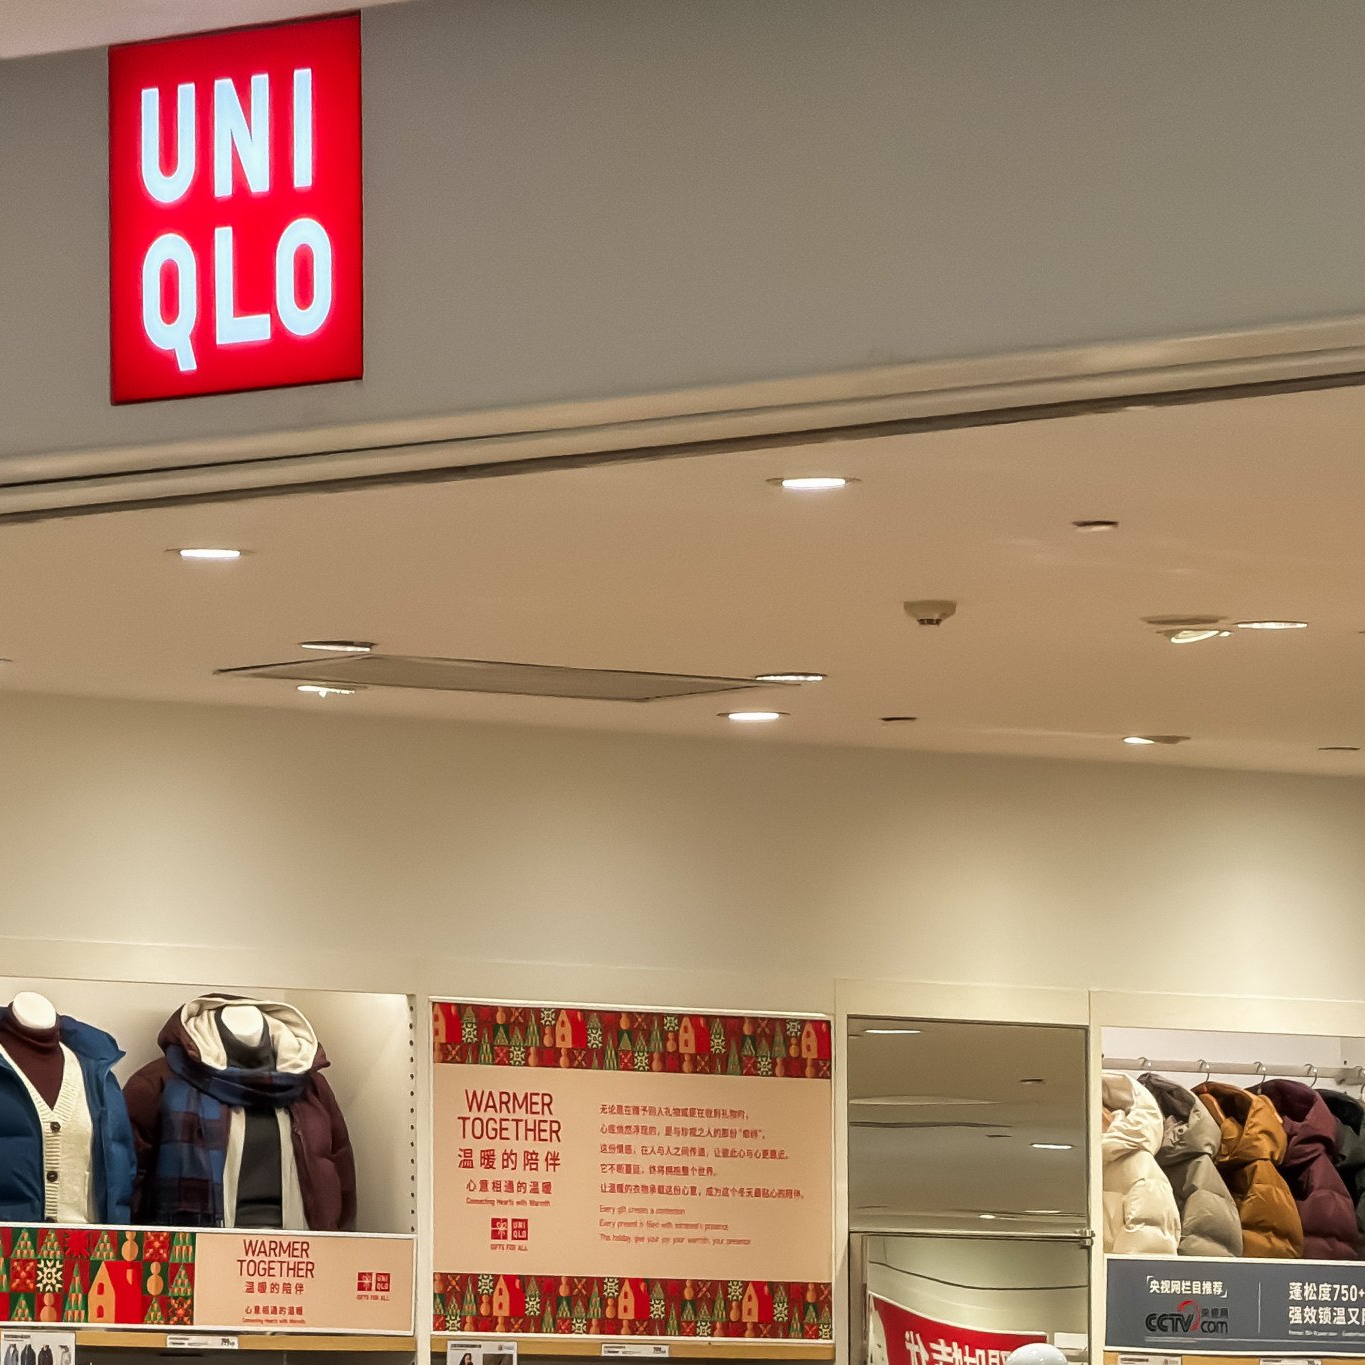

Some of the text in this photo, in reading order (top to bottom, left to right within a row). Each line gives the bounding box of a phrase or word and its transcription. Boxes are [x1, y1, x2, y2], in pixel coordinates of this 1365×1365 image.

[141, 67, 312, 203] UNI
[142, 218, 332, 371] QLO
[465, 1089, 554, 1115] WARMER
[457, 1116, 562, 1143] TOGETHER
[458, 1148, 561, 1173] 温暖的陪伴
[466, 1179, 552, 1195] 心意相通的温暖
[243, 1239, 310, 1258] WARMER
[237, 1259, 315, 1278] TOGETHER
[245, 1281, 304, 1295] 温暖的陪伴
[1145, 1313, 1194, 1332] CCTV
